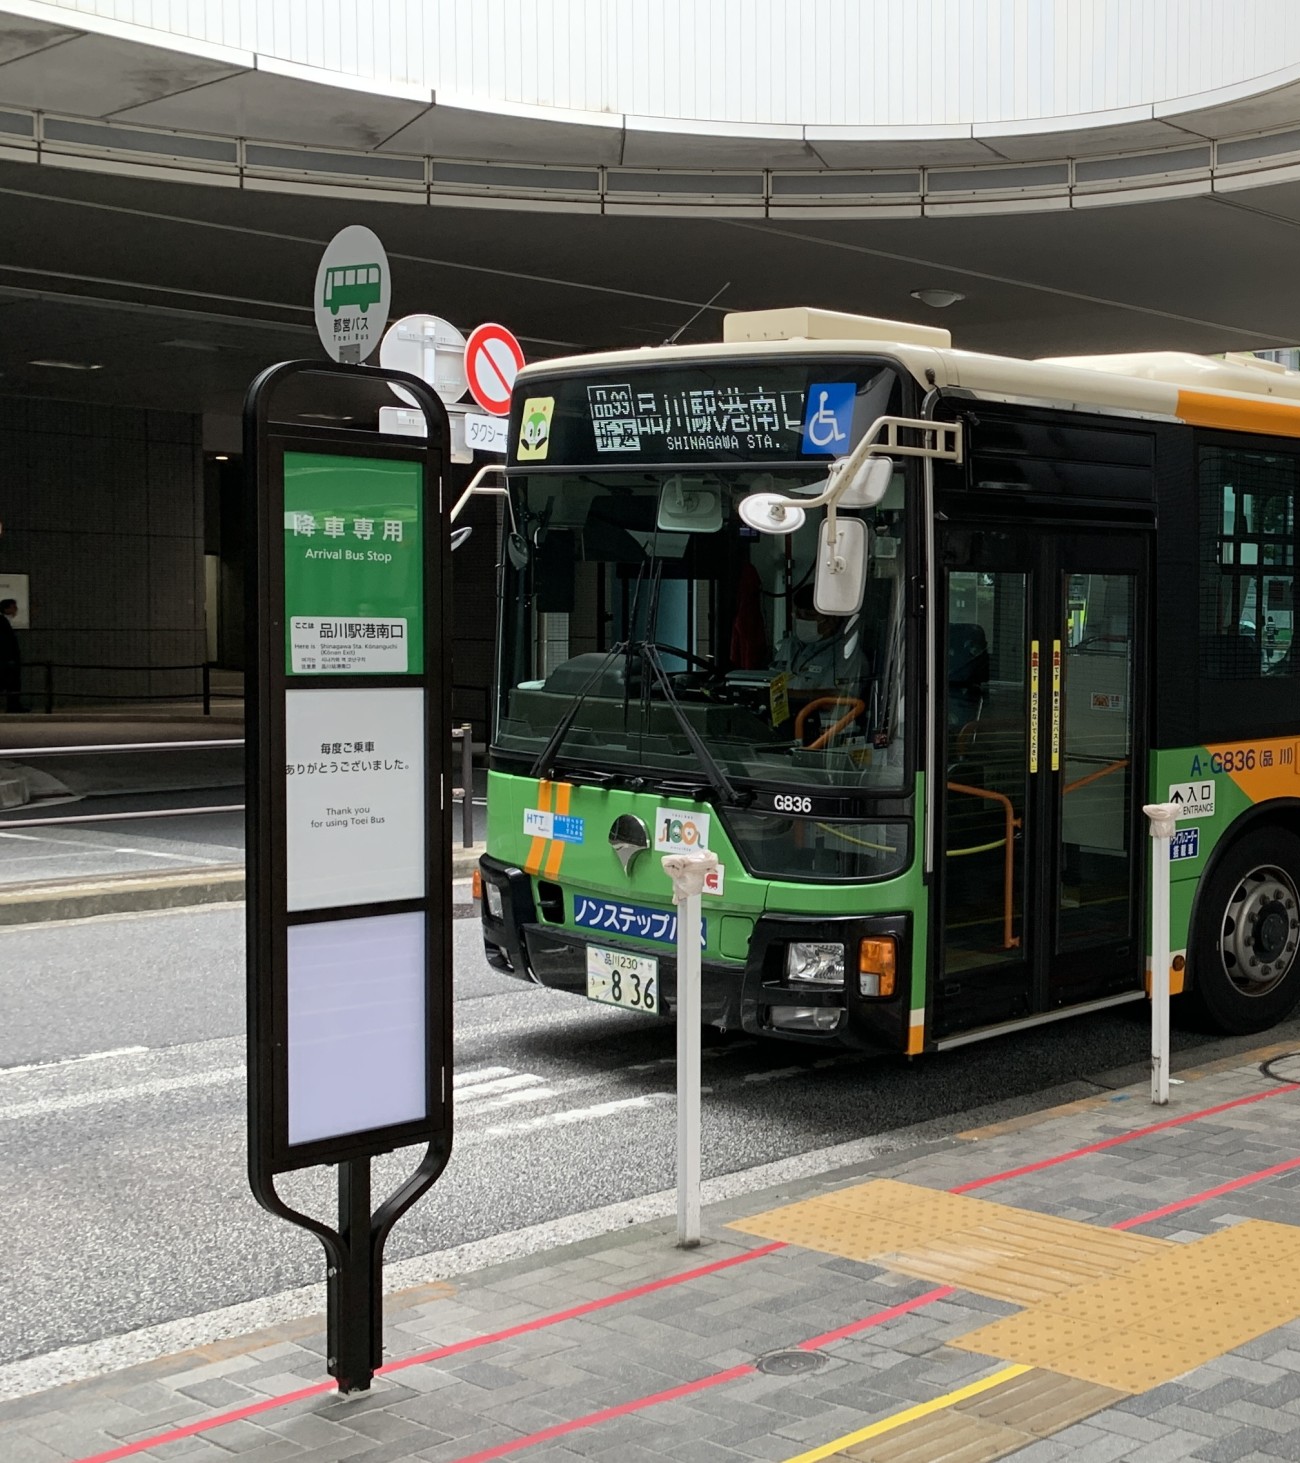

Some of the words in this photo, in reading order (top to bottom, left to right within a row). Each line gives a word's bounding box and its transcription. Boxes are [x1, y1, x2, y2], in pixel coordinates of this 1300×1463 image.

[333, 317, 369, 333] 都営バス
[666, 435, 739, 450] SHINAGAWA
[747, 434, 780, 448] STA.
[293, 514, 403, 542] 降車専用
[305, 548, 342, 560] Arrival
[345, 550, 365, 561] Bus
[367, 551, 392, 563] Stop
[295, 622, 315, 630] ここは
[319, 622, 404, 639] 品川駅港南口
[320, 643, 352, 651] Shinagawa
[320, 741, 375, 754] 毎度ご乗車
[286, 759, 410, 775] ありがとうございました。
[1190, 749, 1256, 777] A-G836
[1186, 784, 1211, 803] 入口
[326, 807, 351, 816] Thank
[354, 806, 371, 816] you
[774, 795, 812, 813] G836
[1183, 802, 1214, 816] ENTRANCE
[310, 820, 323, 828] for
[325, 819, 348, 828] using
[350, 817, 369, 826] Toei
[370, 816, 386, 825] Bus
[526, 813, 545, 826] HTT
